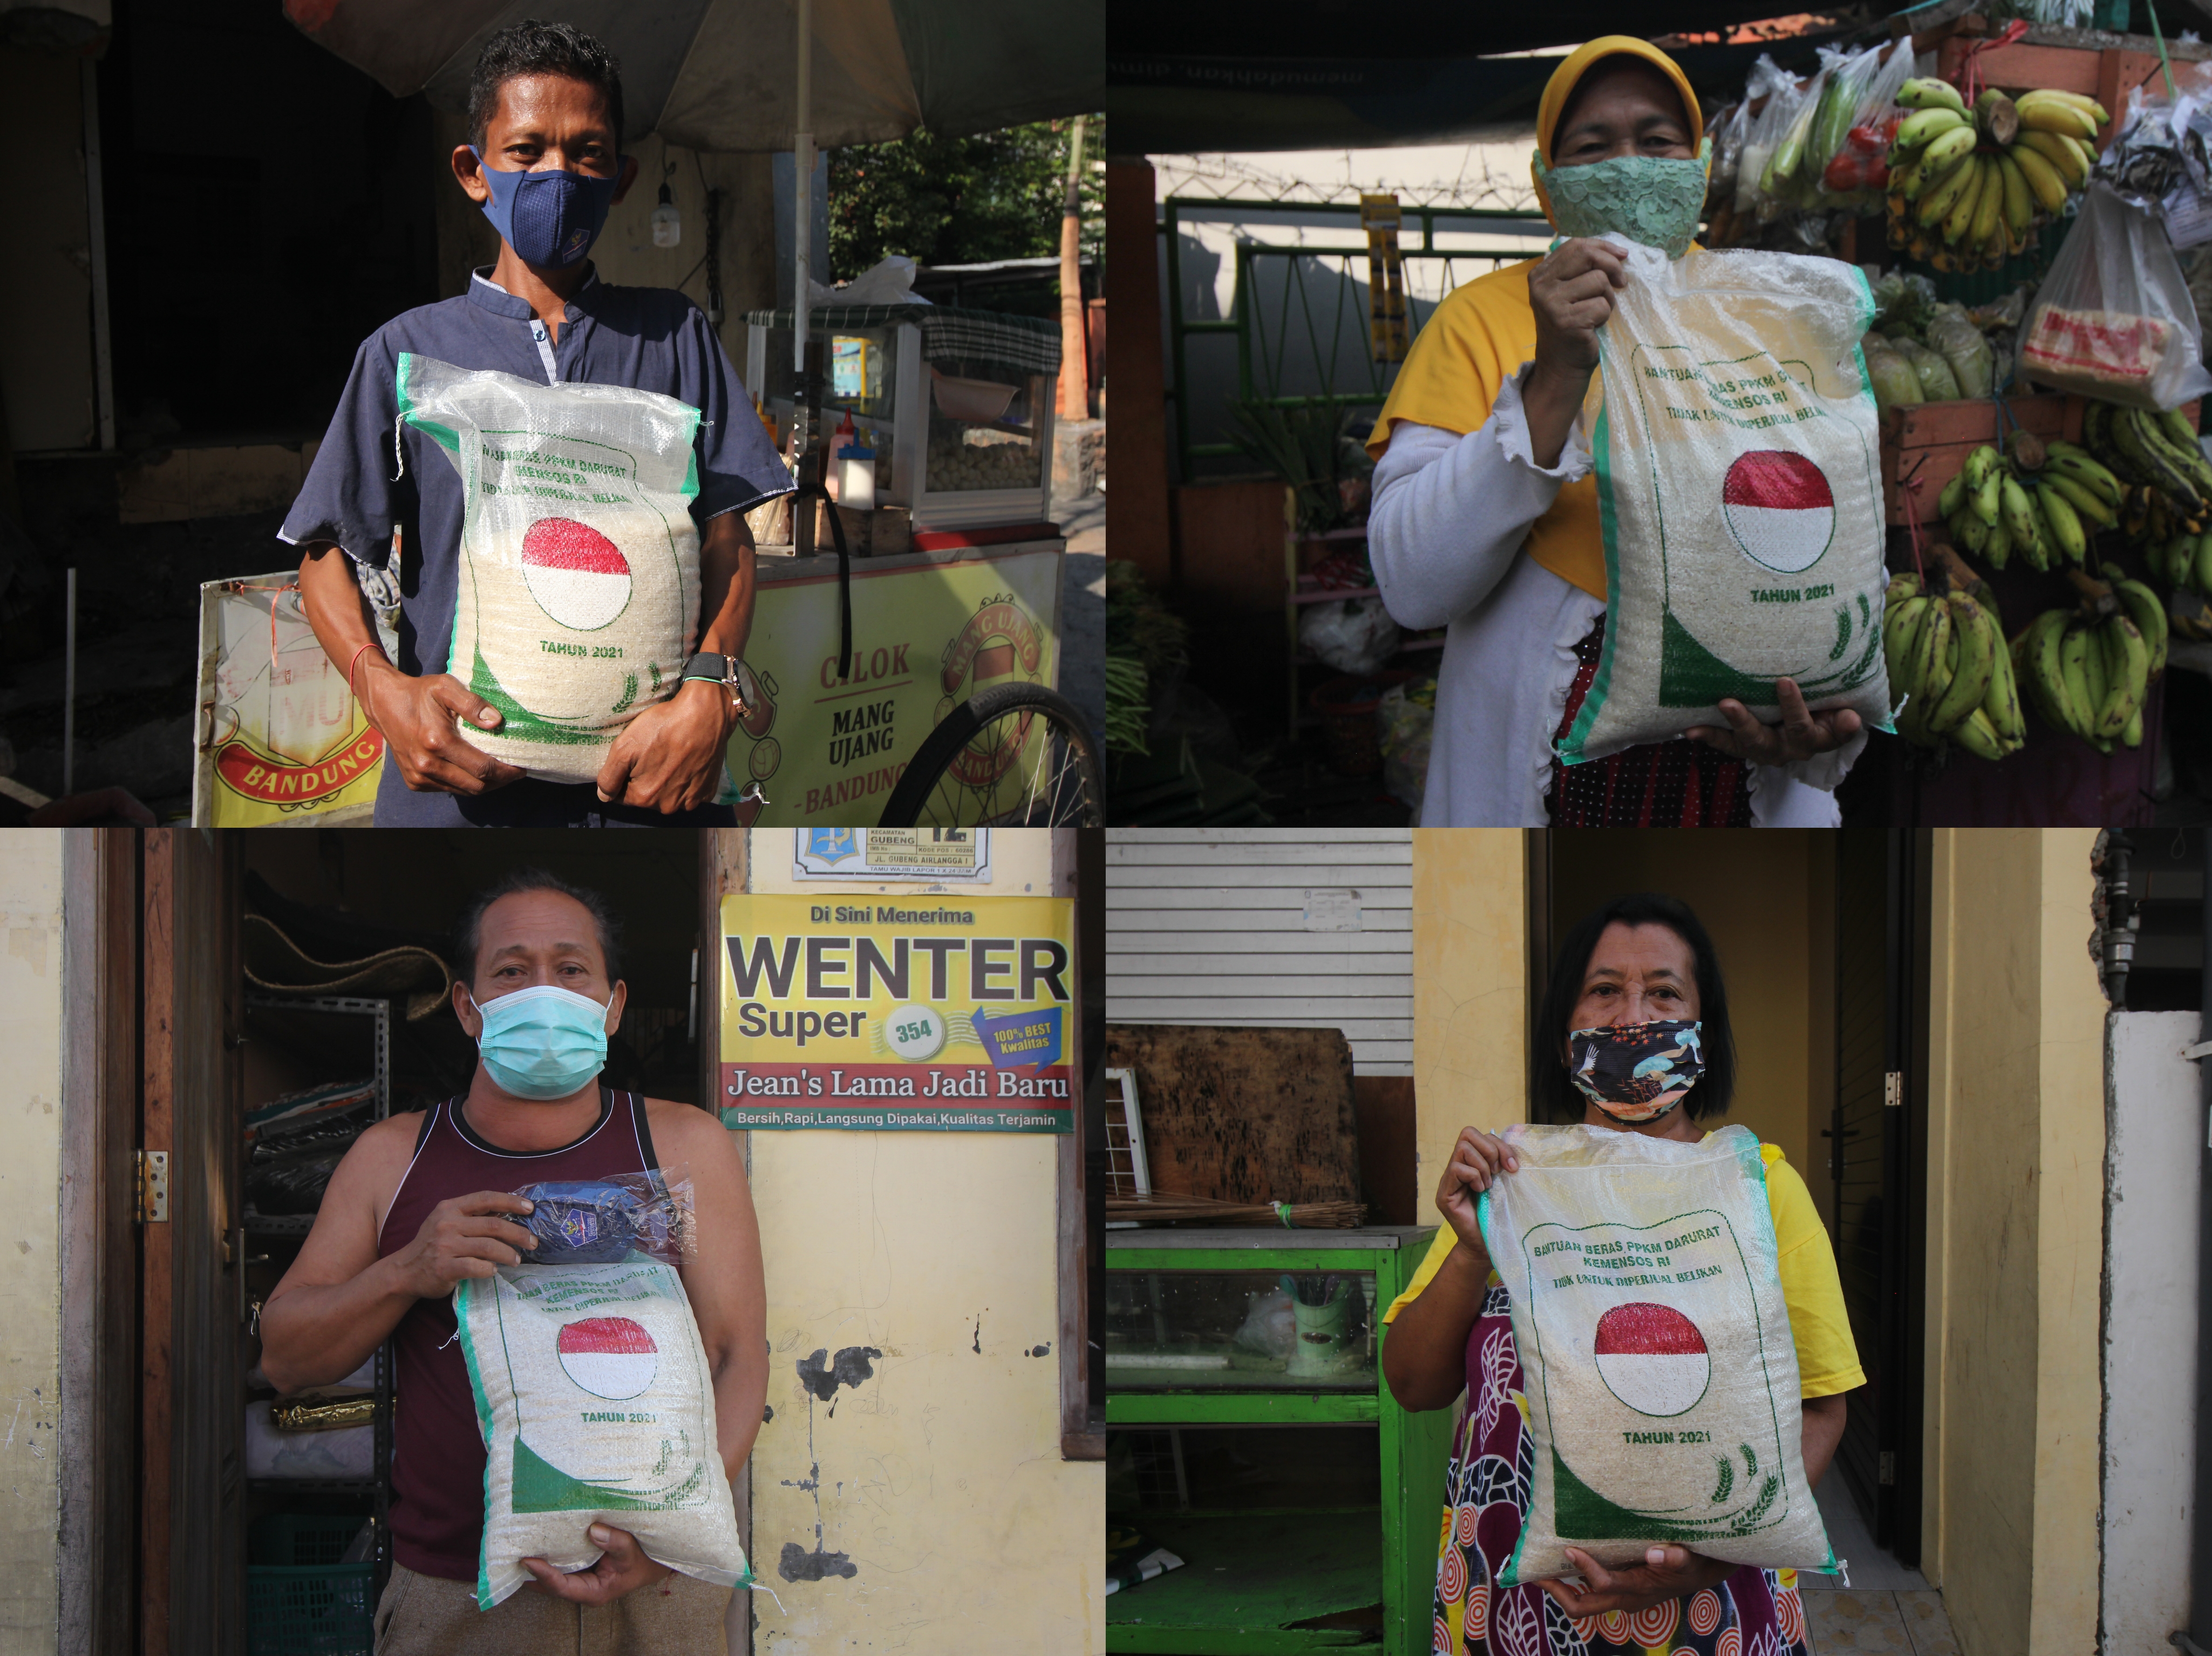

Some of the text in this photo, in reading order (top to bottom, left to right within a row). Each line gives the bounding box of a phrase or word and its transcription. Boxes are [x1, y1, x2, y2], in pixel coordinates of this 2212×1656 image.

[1738, 374, 1776, 390] PPKM
[1772, 390, 1788, 404] RI
[579, 460, 625, 479] DARURAT
[1750, 583, 1834, 603] TAHUN 2021
[540, 640, 623, 658] TAHUN 2021
[951, 611, 1035, 676] MANG UJANG
[820, 643, 910, 689] CLOK
[832, 700, 894, 737] MANG
[829, 726, 894, 768] UJANG
[242, 741, 376, 794] BANDUNG
[870, 836, 915, 844] GUBENG
[811, 906, 974, 923] Di Sini Menerima
[726, 936, 1070, 1000] WENTER
[738, 1003, 866, 1046] Super
[895, 1019, 932, 1044] 354
[993, 1022, 1051, 1043] 100% BEST
[1000, 1037, 1050, 1054] Kwalitas
[727, 1068, 1068, 1099] Jean's Lama Jadi Baru
[997, 1114, 1056, 1128] Terjamin
[1534, 1240, 1582, 1257] BANTUAN
[1626, 1241, 1663, 1253] PPKM
[1665, 1225, 1720, 1251] DARURAT
[1583, 1256, 1671, 1269] KEMENSOS RI
[1576, 1274, 1614, 1286] UNTUK
[1615, 1274, 1675, 1286] DIPERJUAL
[1676, 1264, 1723, 1283] BELIKAN
[542, 1281, 578, 1292] BERAS
[546, 1288, 604, 1304] KEMENSOS
[581, 1412, 656, 1423] TAHUN 2021
[1622, 1430, 1711, 1444] TAHUN 2021
